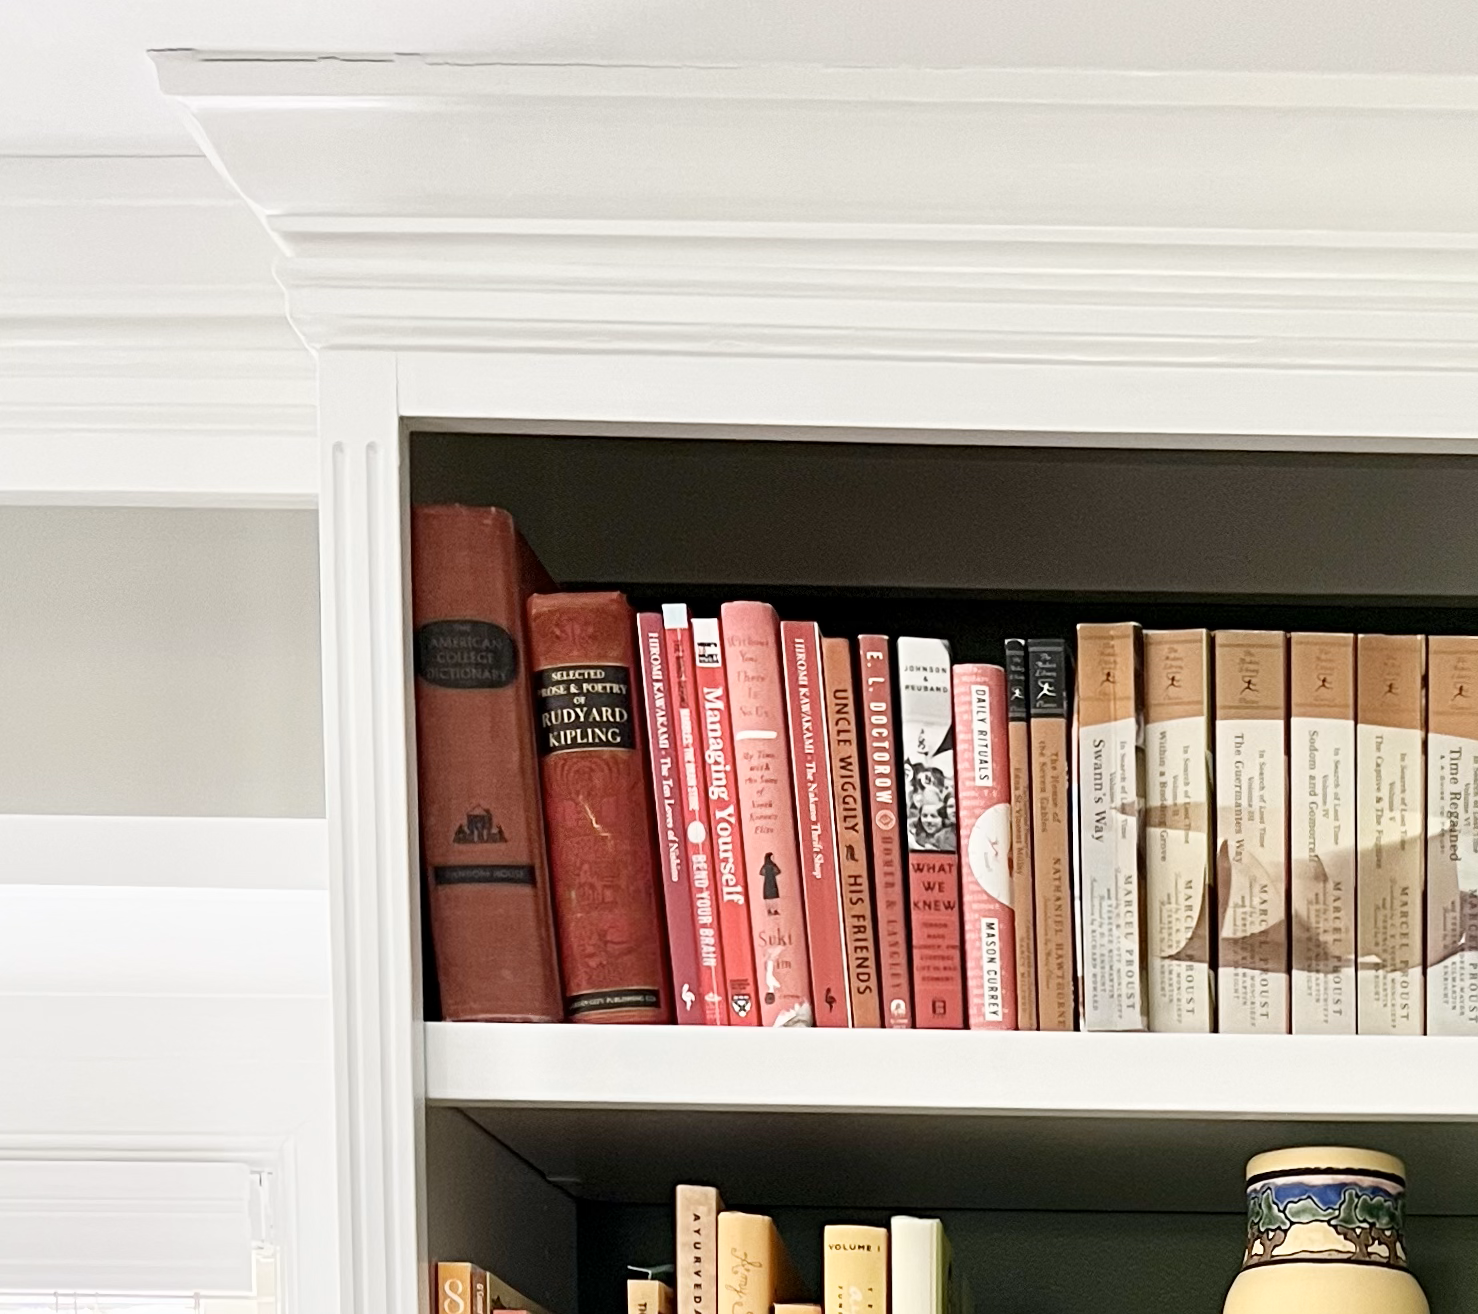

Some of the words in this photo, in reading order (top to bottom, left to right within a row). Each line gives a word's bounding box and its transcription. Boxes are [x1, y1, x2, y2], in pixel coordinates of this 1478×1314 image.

[864, 650, 883, 667] E.
[542, 706, 628, 728] RUDYARD
[833, 688, 849, 748] UNCLE
[976, 688, 988, 727] DAILY
[549, 728, 622, 747] KIPLING
[703, 686, 728, 800] Managing
[869, 701, 893, 805] DOCTOROW
[977, 730, 990, 783] RITUALS
[838, 752, 859, 835] WIGGILY
[715, 805, 745, 904] Yourself
[911, 863, 955, 875] WHAT
[847, 874, 864, 910] HIS
[912, 899, 957, 911] KNEW
[923, 881, 945, 893] WE
[850, 915, 873, 996] FRIENDS
[983, 922, 996, 964] MASON
[984, 965, 1000, 1018] CURREY
